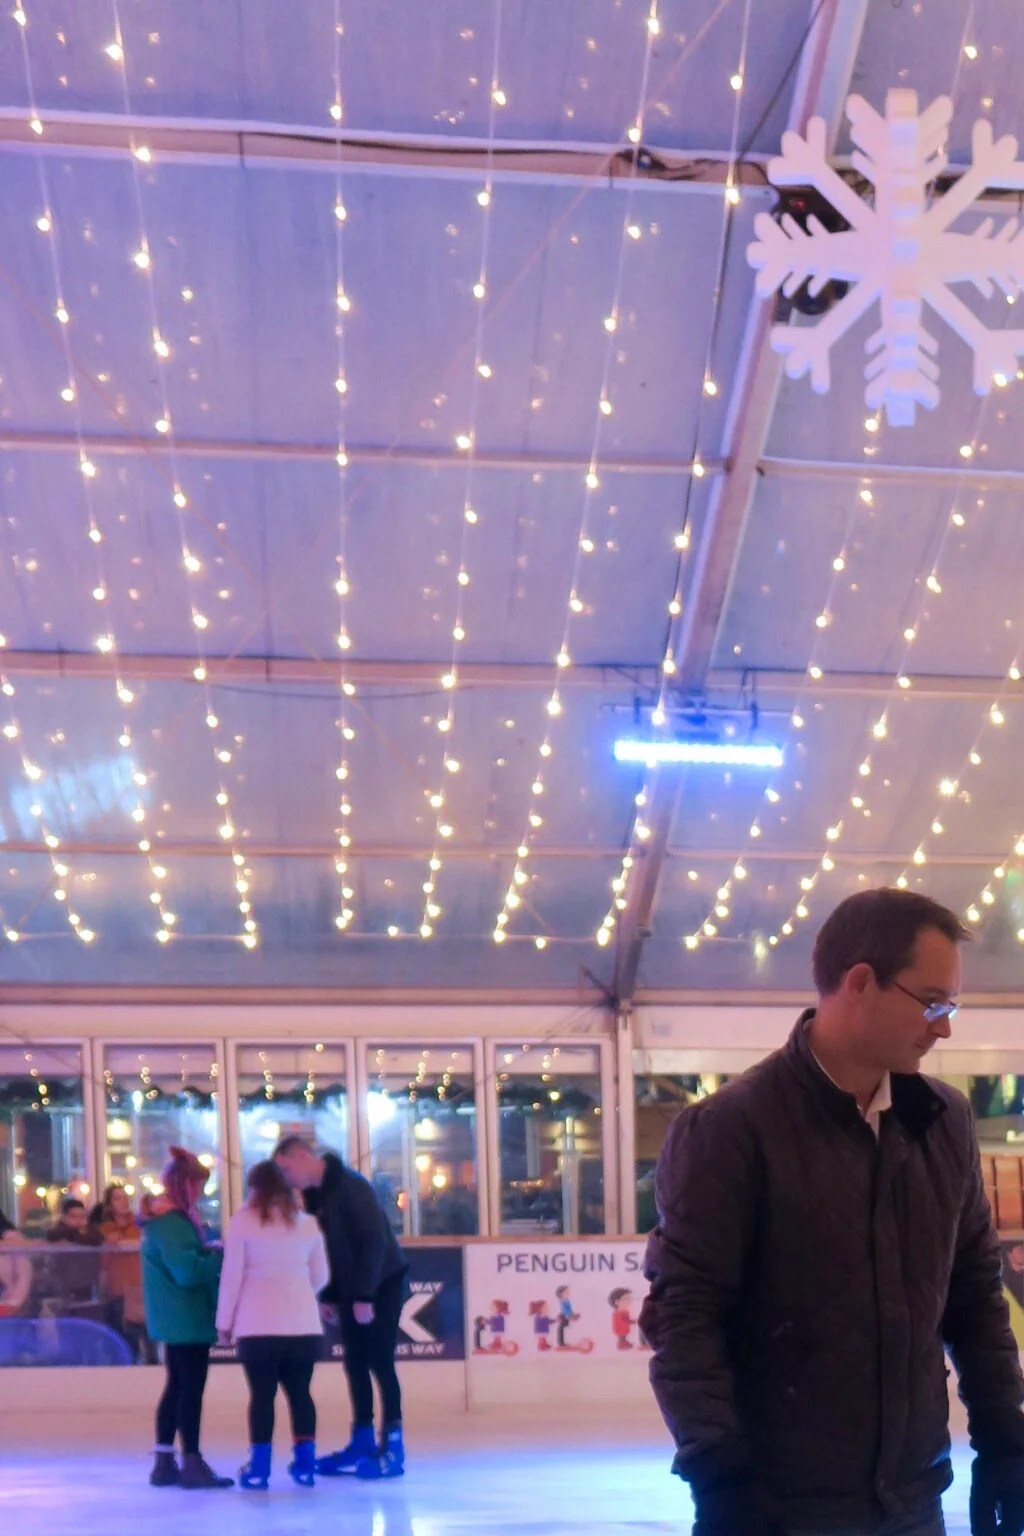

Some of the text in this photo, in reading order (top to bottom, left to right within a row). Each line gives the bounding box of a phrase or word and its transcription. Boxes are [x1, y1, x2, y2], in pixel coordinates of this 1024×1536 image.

[496, 1252, 615, 1273] PENGUIN
[409, 1280, 442, 1293] WAY
[412, 1344, 446, 1355] WAY
